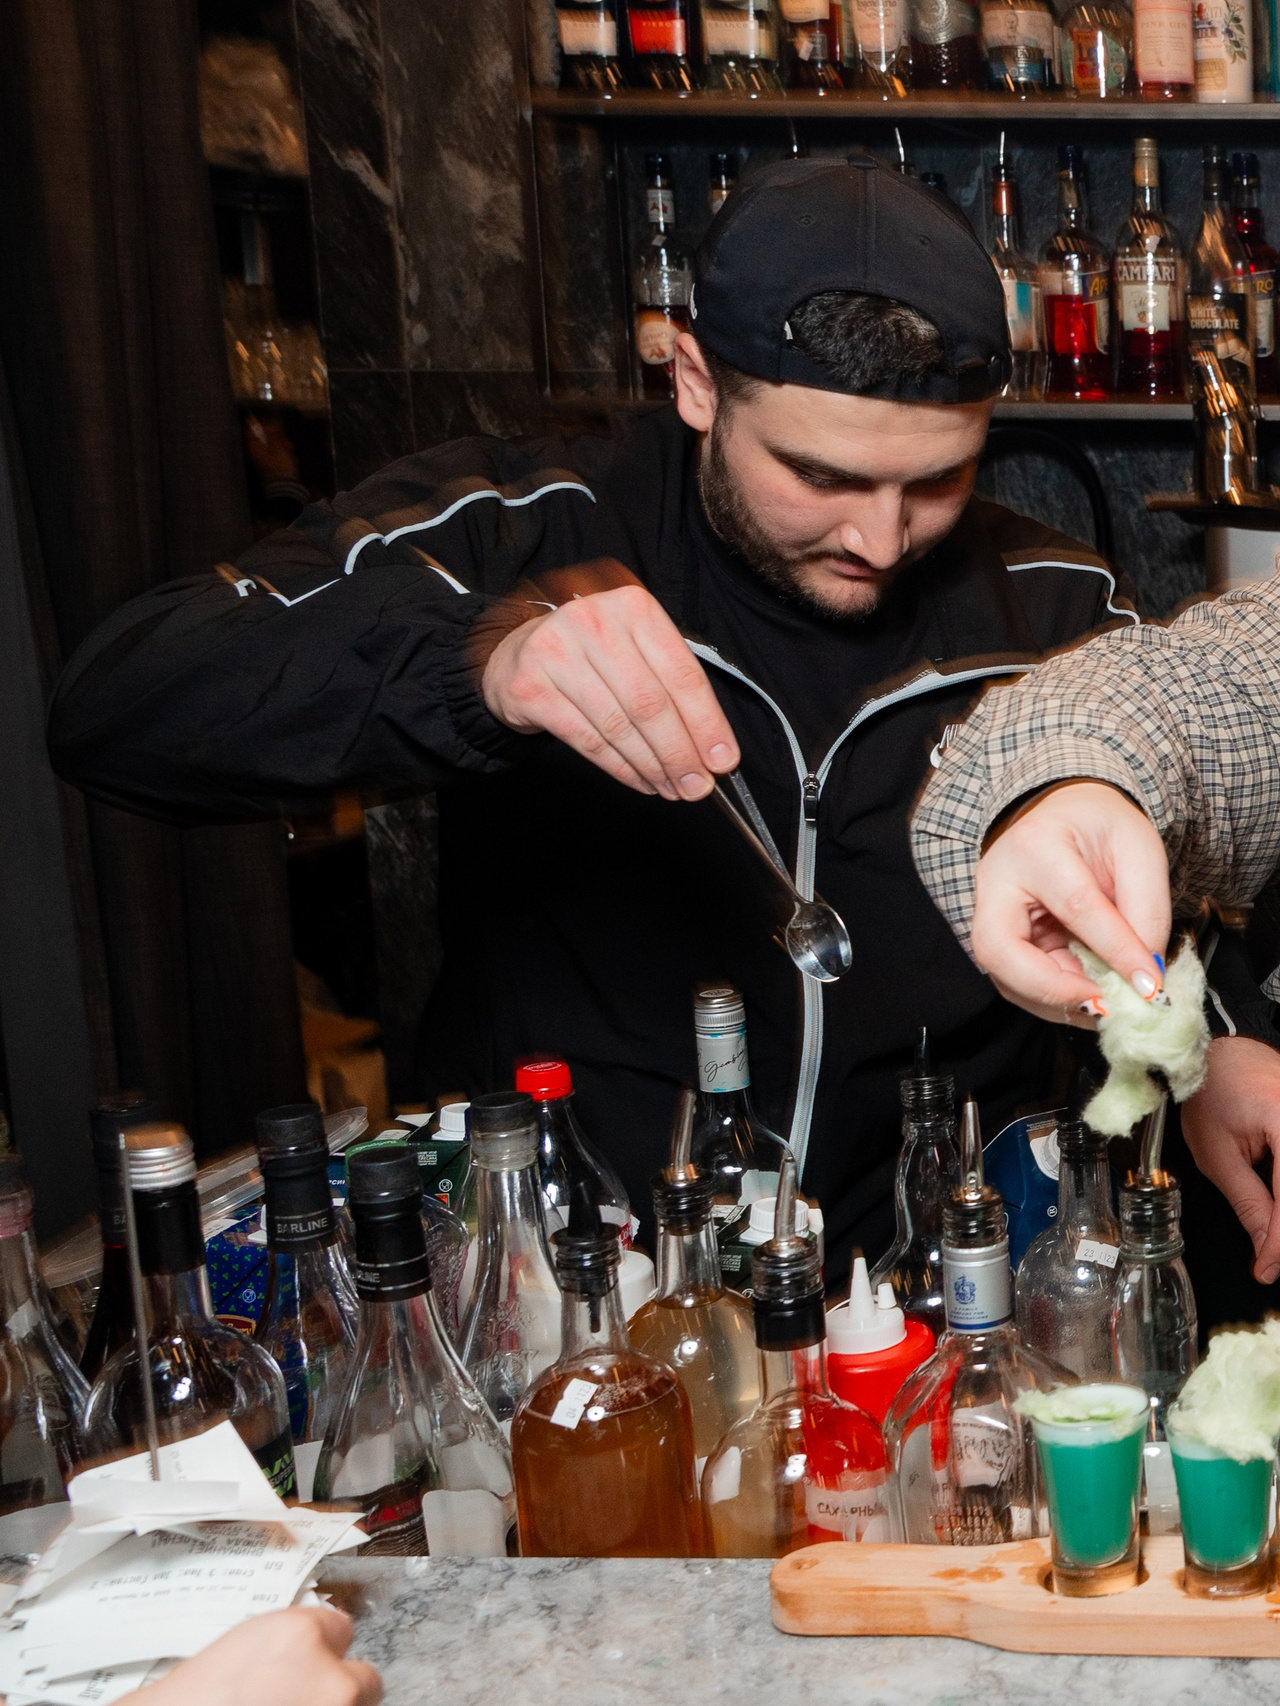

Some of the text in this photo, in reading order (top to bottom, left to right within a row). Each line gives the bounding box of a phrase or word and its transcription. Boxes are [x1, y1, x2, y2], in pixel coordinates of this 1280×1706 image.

[1117, 266, 1175, 282] CAMARI
[1190, 307, 1217, 318] WHITE
[1190, 319, 1240, 330] CHOCOLATE
[276, 1217, 329, 1234] BARLINE
[1084, 1248, 1094, 1258] 23
